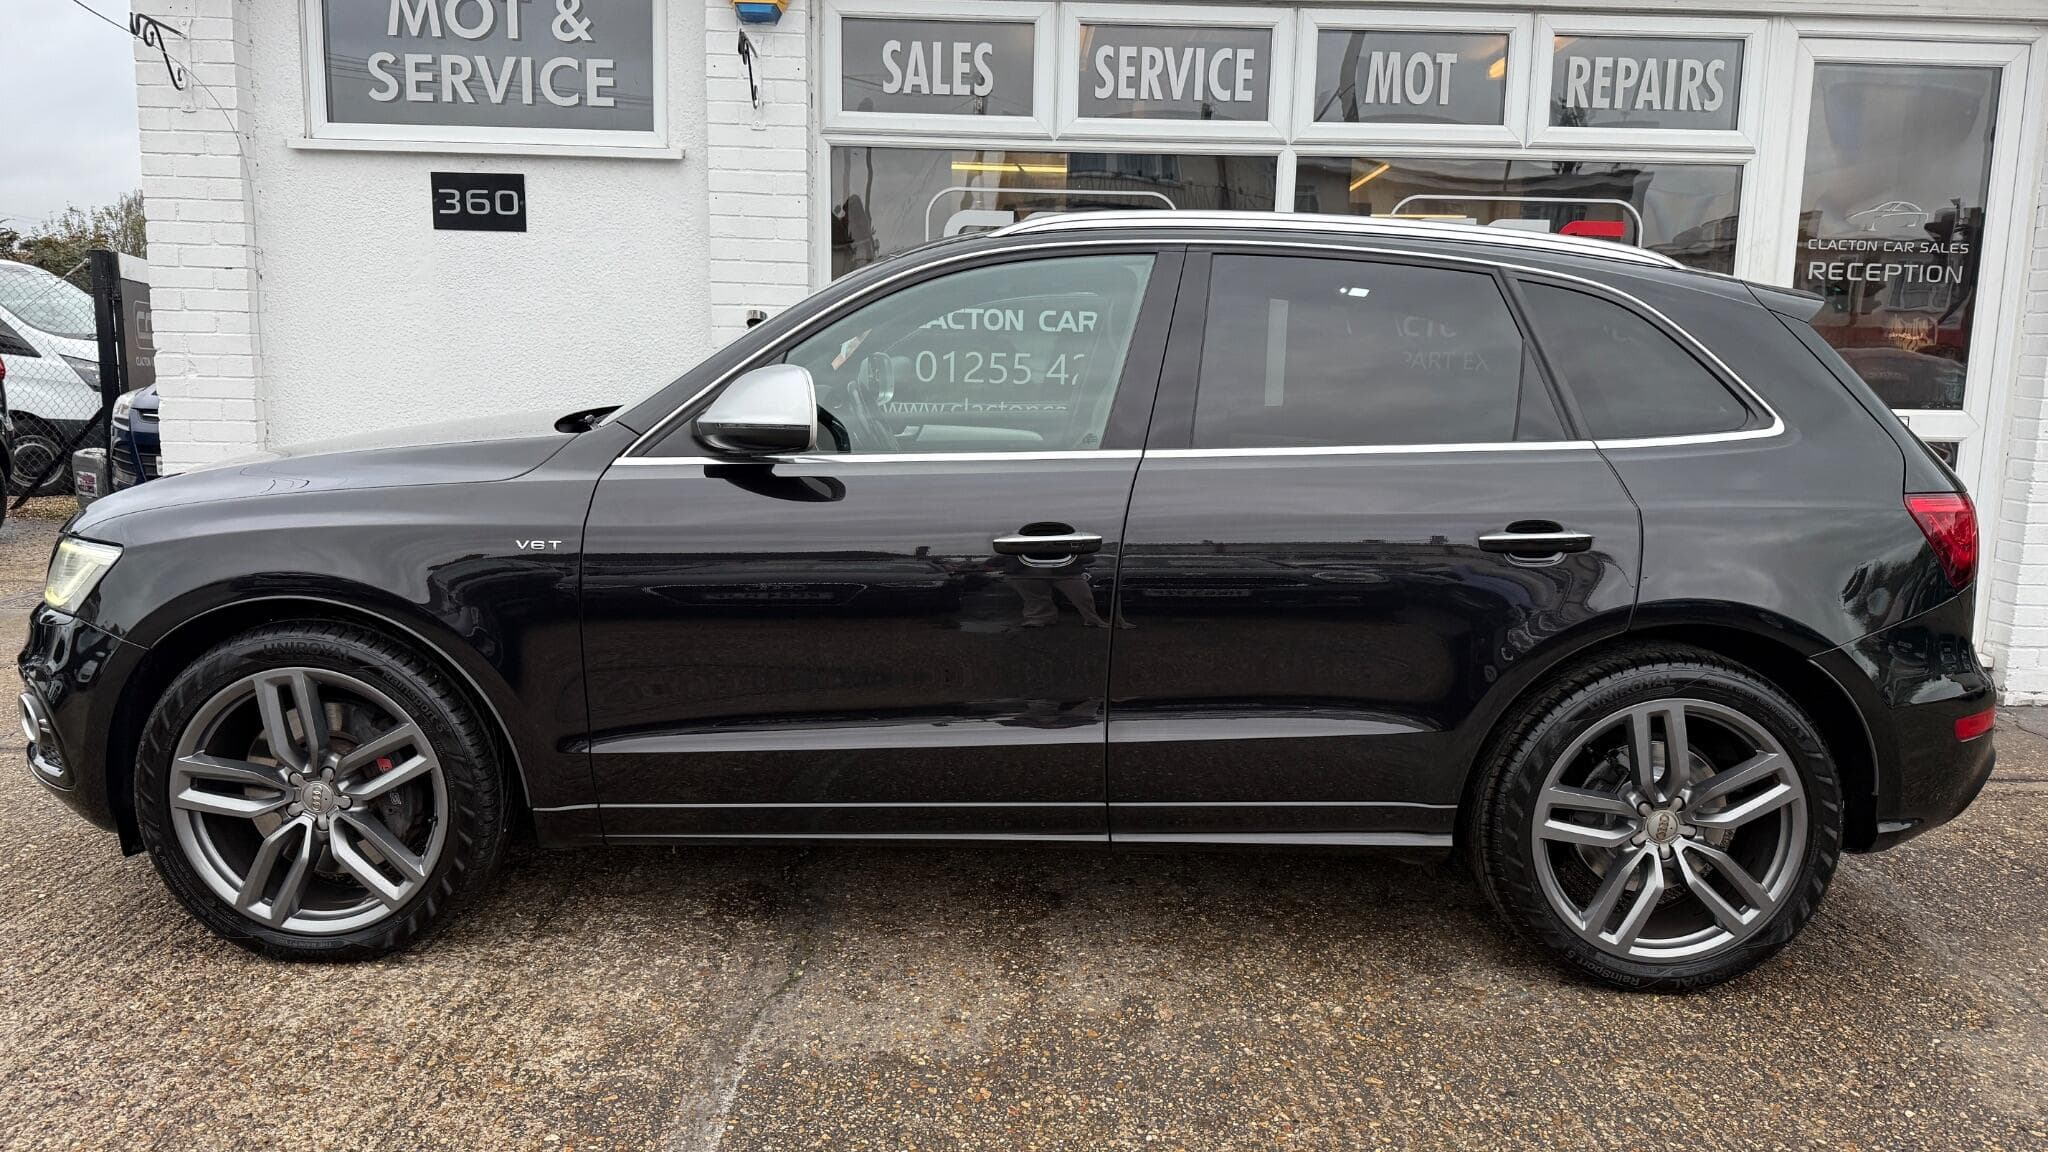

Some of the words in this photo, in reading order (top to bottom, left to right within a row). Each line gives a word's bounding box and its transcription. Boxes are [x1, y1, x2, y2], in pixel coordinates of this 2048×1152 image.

[387, 0, 522, 40] MOT
[551, 0, 593, 41] &
[367, 52, 615, 107] SERVICE
[882, 39, 994, 97] SALES
[1094, 44, 1255, 102] SERVICE
[1365, 50, 1458, 106] MOT
[1566, 55, 1726, 113] REPAIRS
[438, 189, 519, 215] 360
[1808, 238, 1878, 252] CLACTON
[1883, 241, 1915, 253] CAR
[1919, 242, 1970, 255] SALES
[1807, 261, 1963, 284] RECEPTION
[918, 308, 1024, 332] ACTON
[1038, 310, 1098, 333] CAR
[915, 350, 1033, 385] 01255
